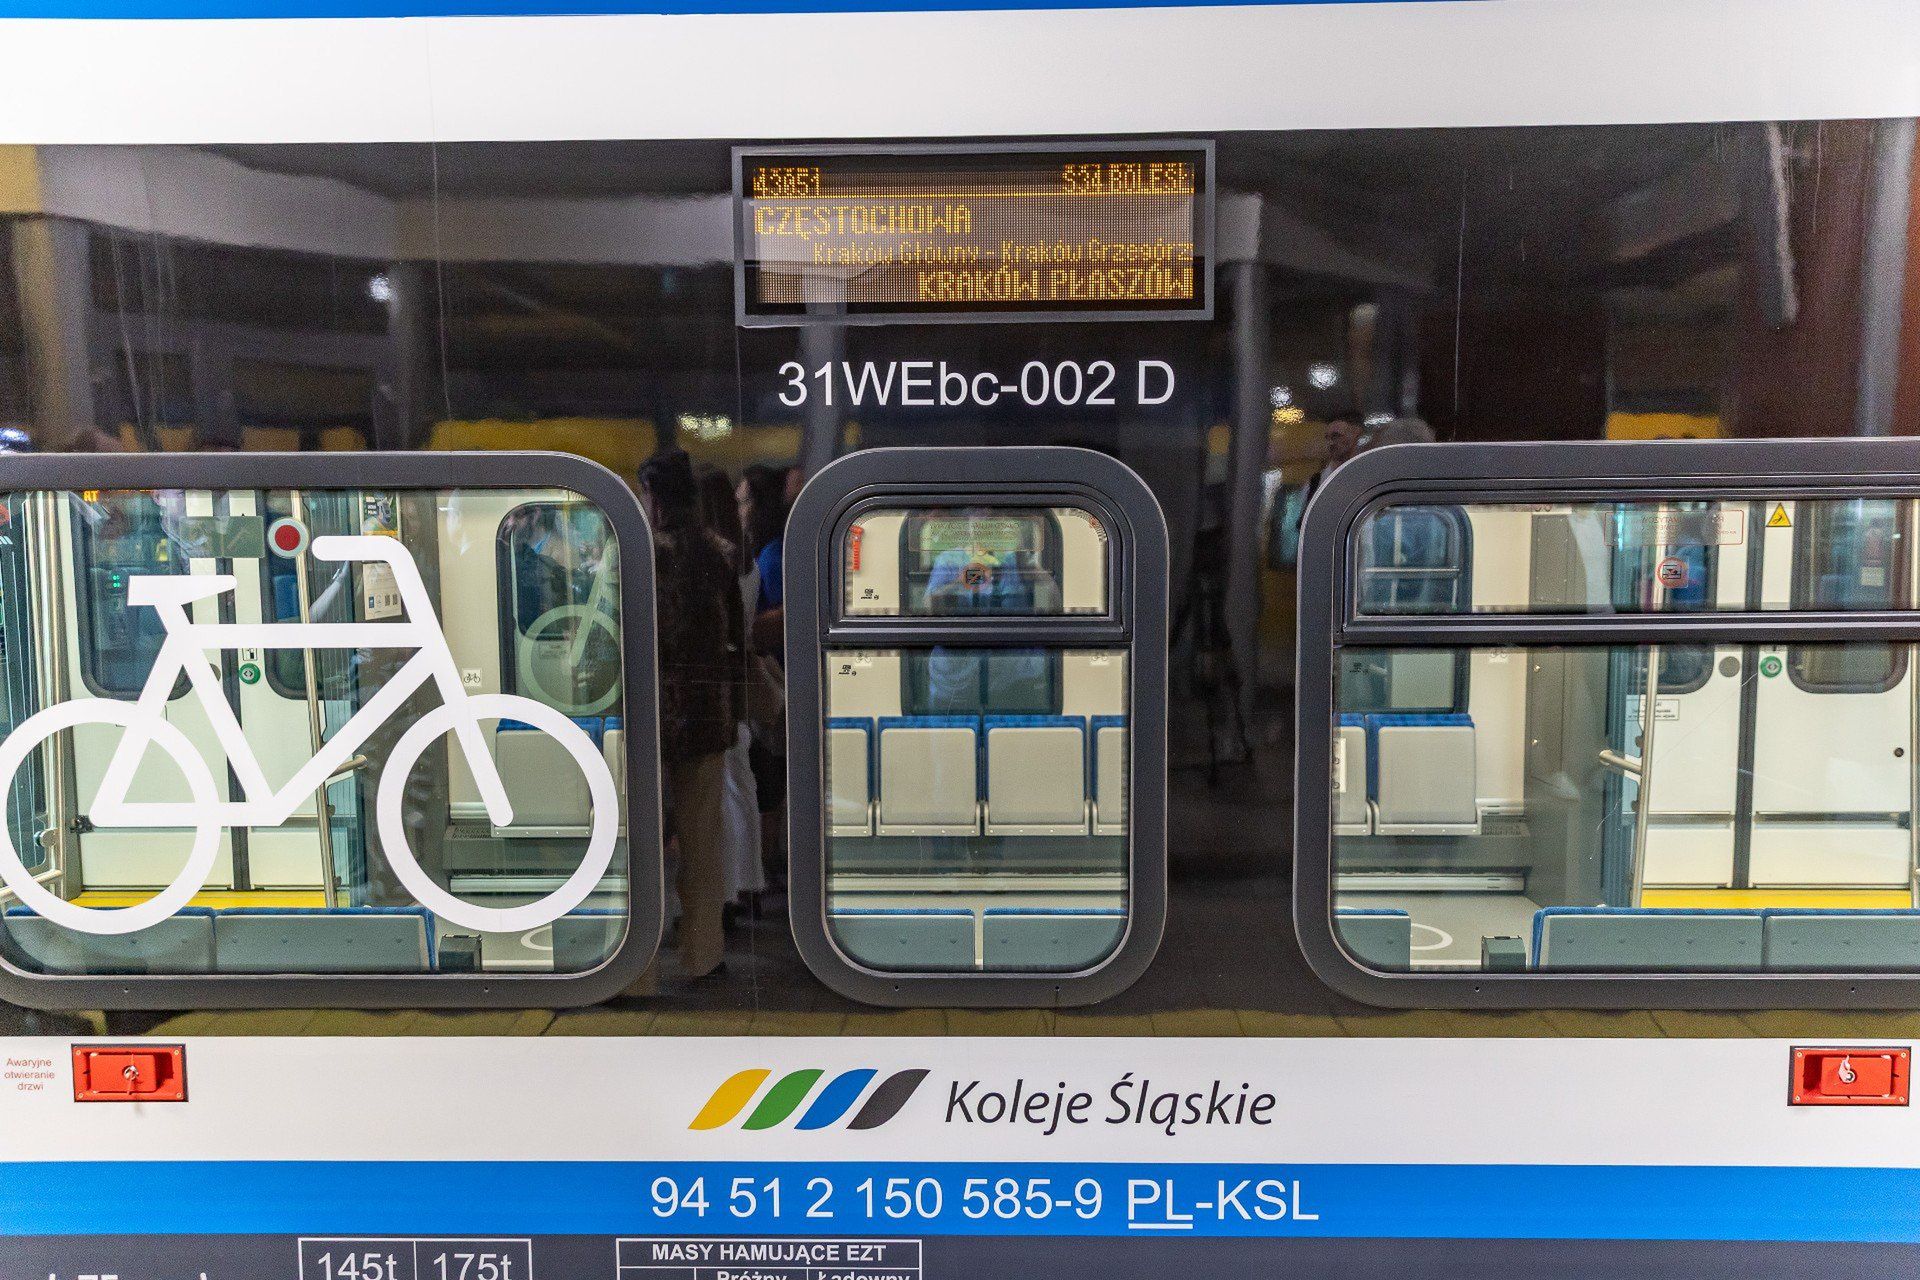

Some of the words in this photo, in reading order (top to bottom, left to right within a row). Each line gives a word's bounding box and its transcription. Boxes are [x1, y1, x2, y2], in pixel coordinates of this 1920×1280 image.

[754, 204, 971, 240] CZĘSTOCHOWA
[814, 241, 893, 265] Kraków
[900, 240, 979, 264] Główny
[1002, 240, 1083, 263] Kraków
[918, 264, 1038, 301] KRAKÓW
[1050, 262, 1193, 299] PŁASZÓW
[778, 360, 1116, 407] 31WEbc-002
[1138, 360, 1175, 406] D
[4, 1071, 56, 1079] otwieranie
[6, 1058, 53, 1069] Awaryjne
[17, 1082, 44, 1091] drzwi
[945, 1079, 1093, 1136] Koleje
[1105, 1072, 1276, 1136] Śląskie
[650, 1176, 710, 1218] 94
[729, 1177, 780, 1218] 51
[805, 1177, 834, 1218] 2
[856, 1177, 943, 1219] 150
[962, 1178, 1103, 1220] 585-9
[1127, 1179, 1320, 1229] PL-KSL
[317, 1252, 398, 1280] 145t
[433, 1252, 512, 1280] 175t
[652, 1243, 713, 1261] MASY
[720, 1244, 840, 1265] HAMUJĄCE
[847, 1245, 887, 1262] EZT
